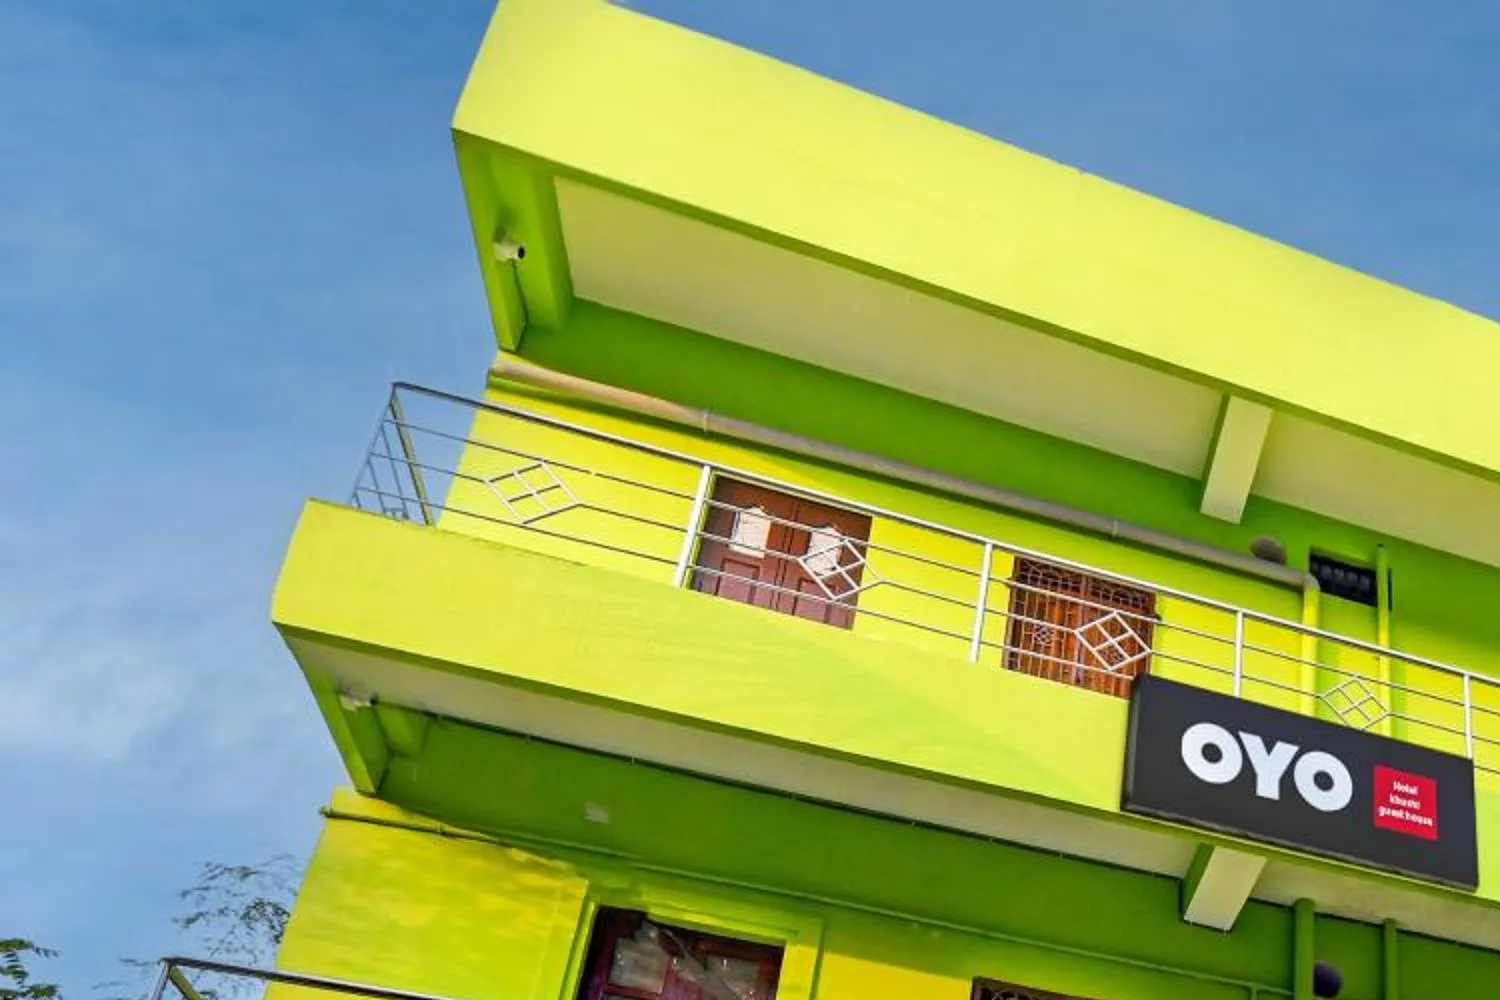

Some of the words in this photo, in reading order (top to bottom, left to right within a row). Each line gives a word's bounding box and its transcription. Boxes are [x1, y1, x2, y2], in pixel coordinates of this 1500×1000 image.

[1181, 722, 1353, 812] OYO
[1393, 780, 1419, 795] Hotel
[1405, 811, 1432, 827] house
